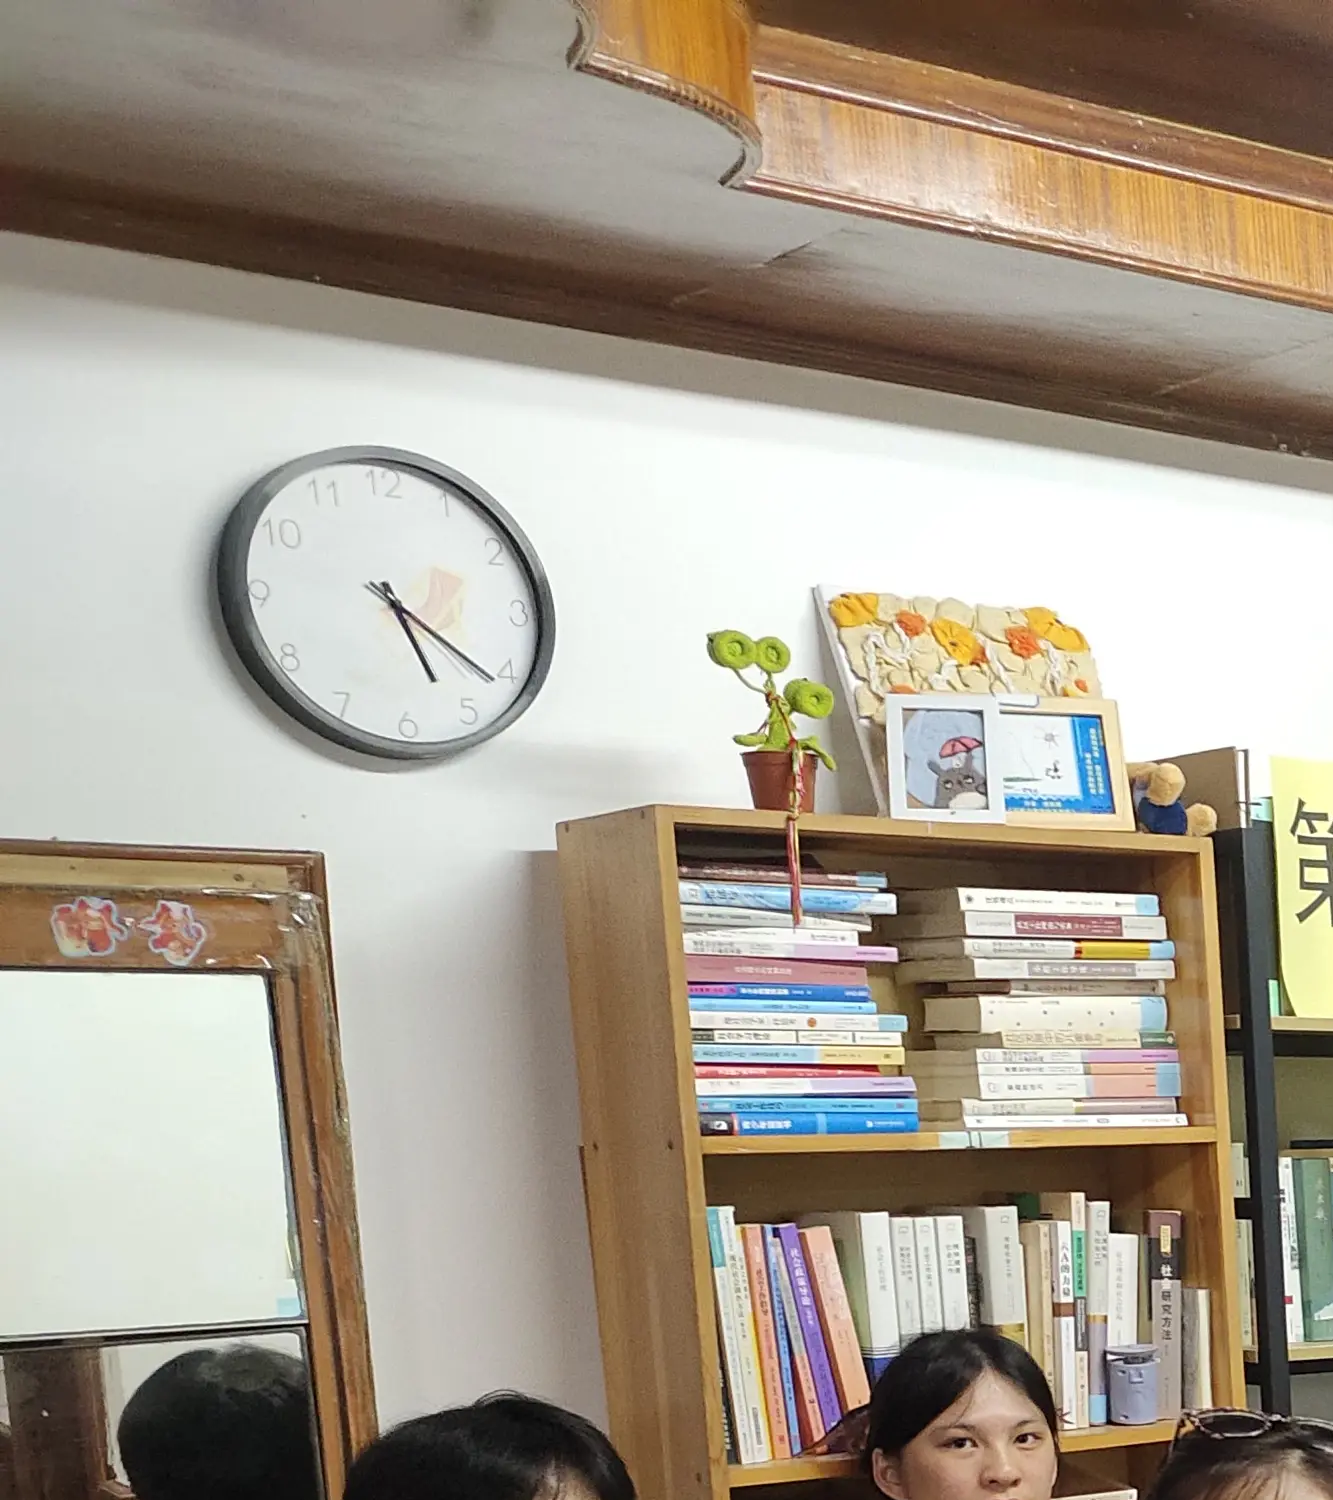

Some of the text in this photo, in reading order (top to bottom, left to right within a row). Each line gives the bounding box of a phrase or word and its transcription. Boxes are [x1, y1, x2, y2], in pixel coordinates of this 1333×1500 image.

[307, 479, 341, 507] 11
[366, 469, 402, 499] 12
[439, 493, 451, 518] 1
[263, 519, 301, 549] 10
[486, 537, 505, 566] 2
[249, 579, 270, 607] 9
[509, 600, 529, 627] 3
[280, 644, 301, 672] 8
[497, 659, 518, 684] 4
[333, 692, 351, 719] 7
[461, 698, 478, 725] 5
[399, 711, 419, 739] 6
